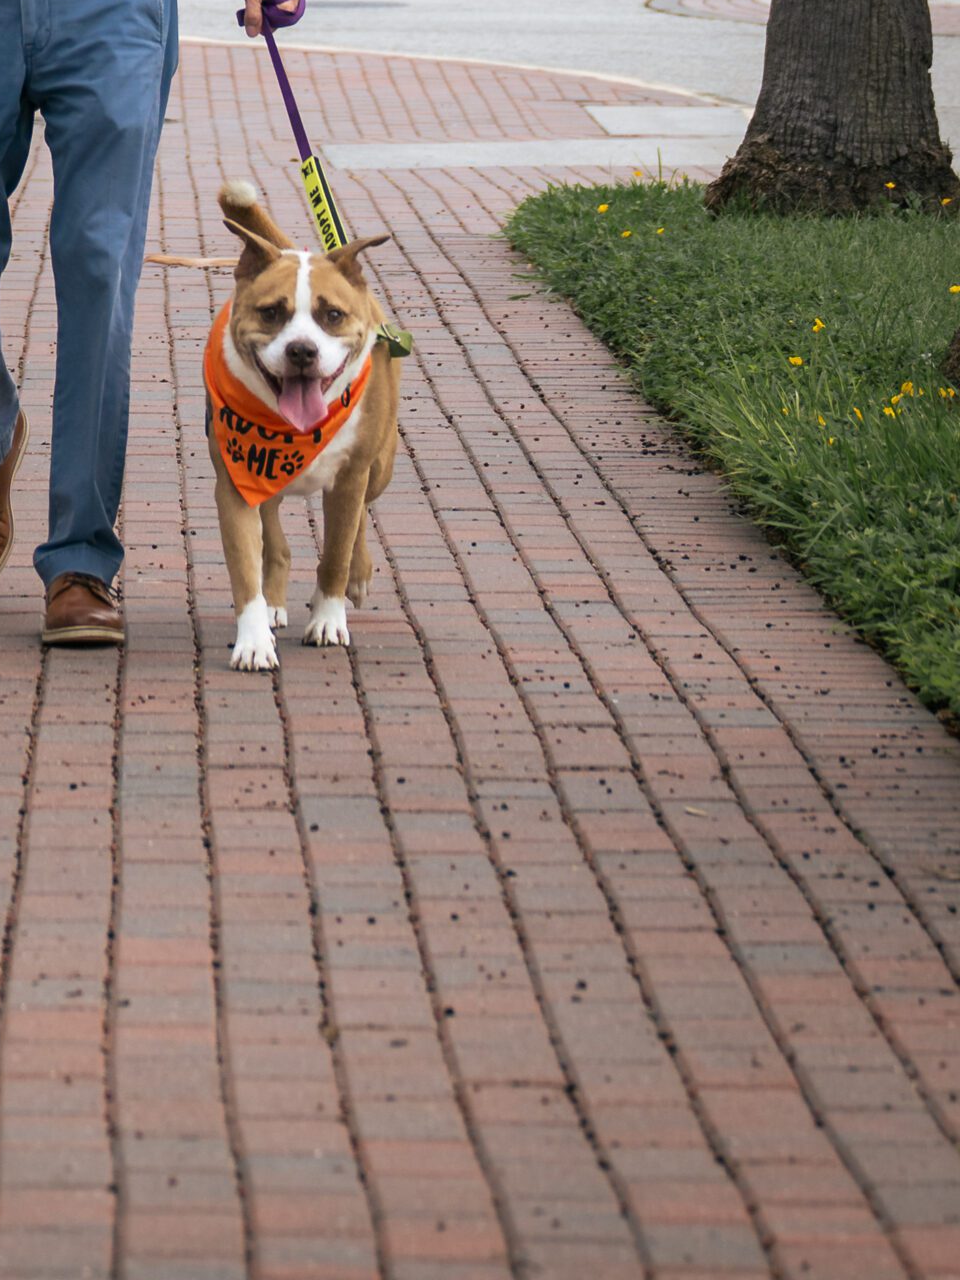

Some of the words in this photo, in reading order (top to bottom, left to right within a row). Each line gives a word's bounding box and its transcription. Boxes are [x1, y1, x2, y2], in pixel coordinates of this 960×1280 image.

[309, 185, 323, 209] ME
[317, 209, 337, 251] ADOPT
[247, 444, 283, 480] ME
